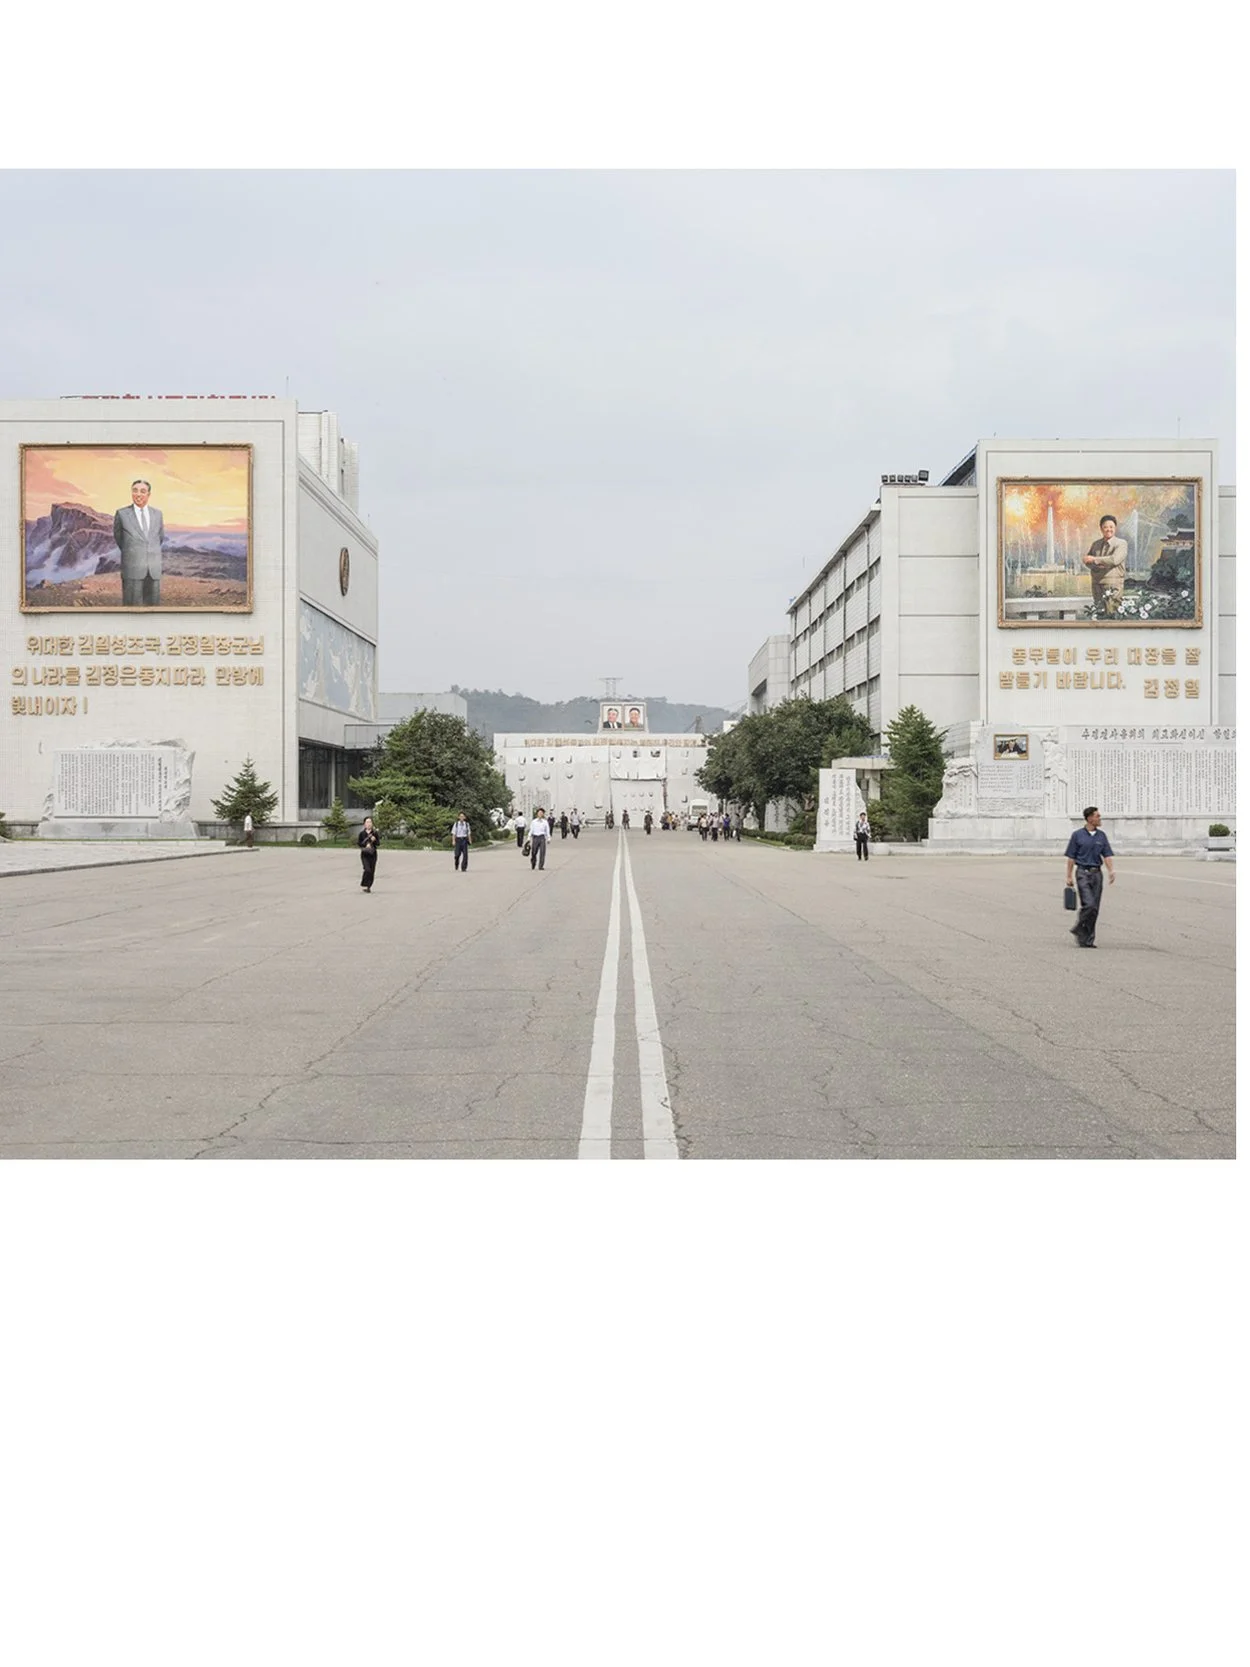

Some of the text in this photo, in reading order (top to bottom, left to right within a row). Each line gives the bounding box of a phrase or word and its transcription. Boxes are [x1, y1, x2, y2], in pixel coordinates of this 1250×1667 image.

[27, 635, 75, 656] 위대한
[166, 635, 265, 656] 김정일장군님
[1011, 647, 1202, 666] 동무들이 우리 대장을 잘
[11, 665, 265, 686] 의 나라를 김정은동지따라 만방에
[999, 671, 1126, 690] 받들기 바랍니다.
